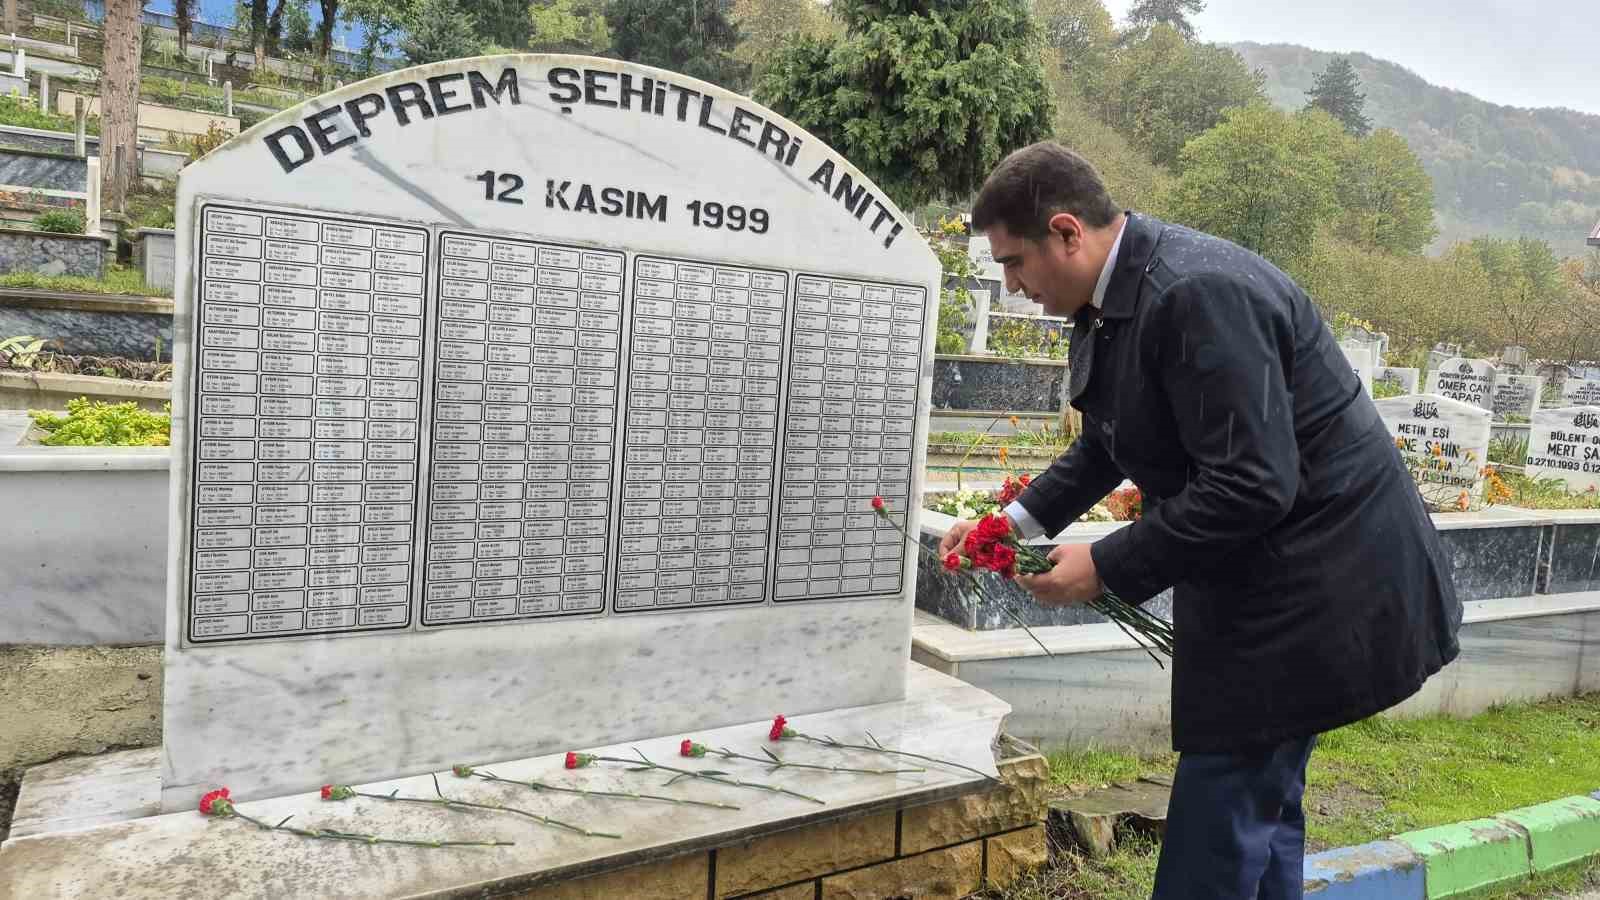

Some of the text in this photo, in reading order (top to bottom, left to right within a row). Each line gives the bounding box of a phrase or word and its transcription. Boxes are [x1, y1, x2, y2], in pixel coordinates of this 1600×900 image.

[263, 67, 521, 175] DEPREM
[476, 169, 770, 234] 12 KASIM 1999
[1438, 379, 1491, 394] ÖMER CAN
[1397, 423, 1427, 435] METİN
[1550, 430, 1587, 443] BÜLENT
[1547, 443, 1577, 457] MERT
